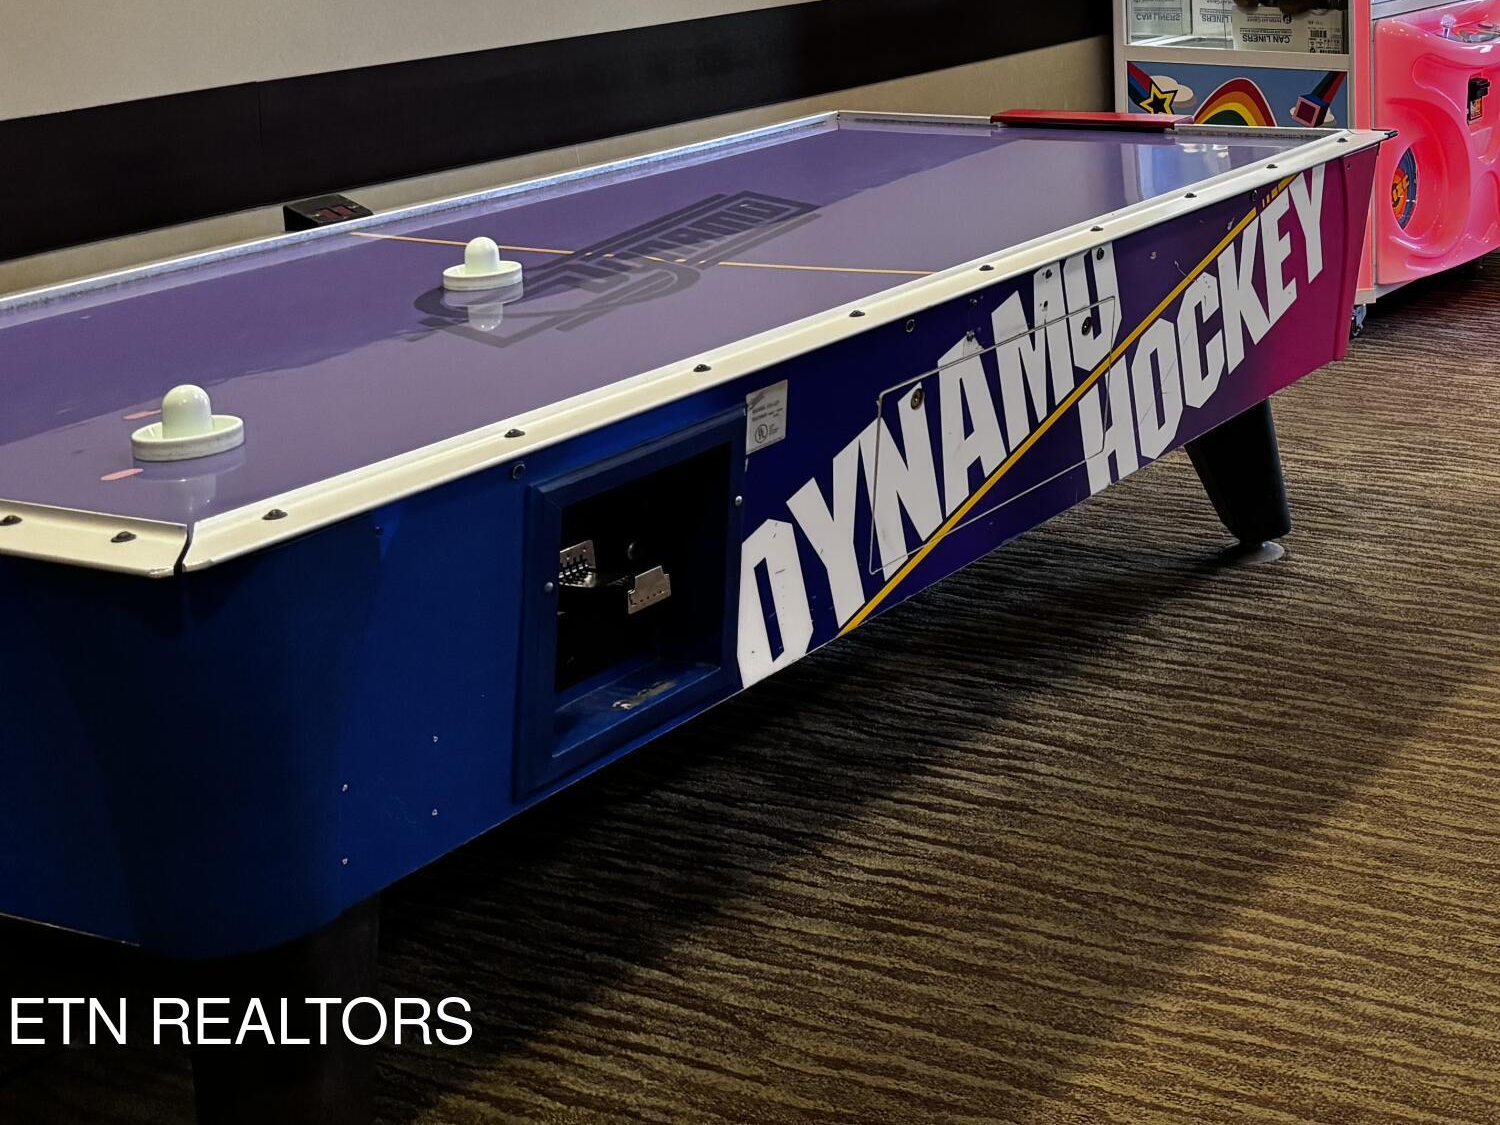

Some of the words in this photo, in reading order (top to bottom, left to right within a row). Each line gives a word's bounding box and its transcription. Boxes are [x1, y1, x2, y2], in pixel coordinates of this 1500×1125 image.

[1242, 33, 1270, 43] LINERS
[1273, 34, 1290, 44] CAN
[1077, 164, 1326, 497] HOCKEY
[736, 239, 1123, 689] DYNAMO
